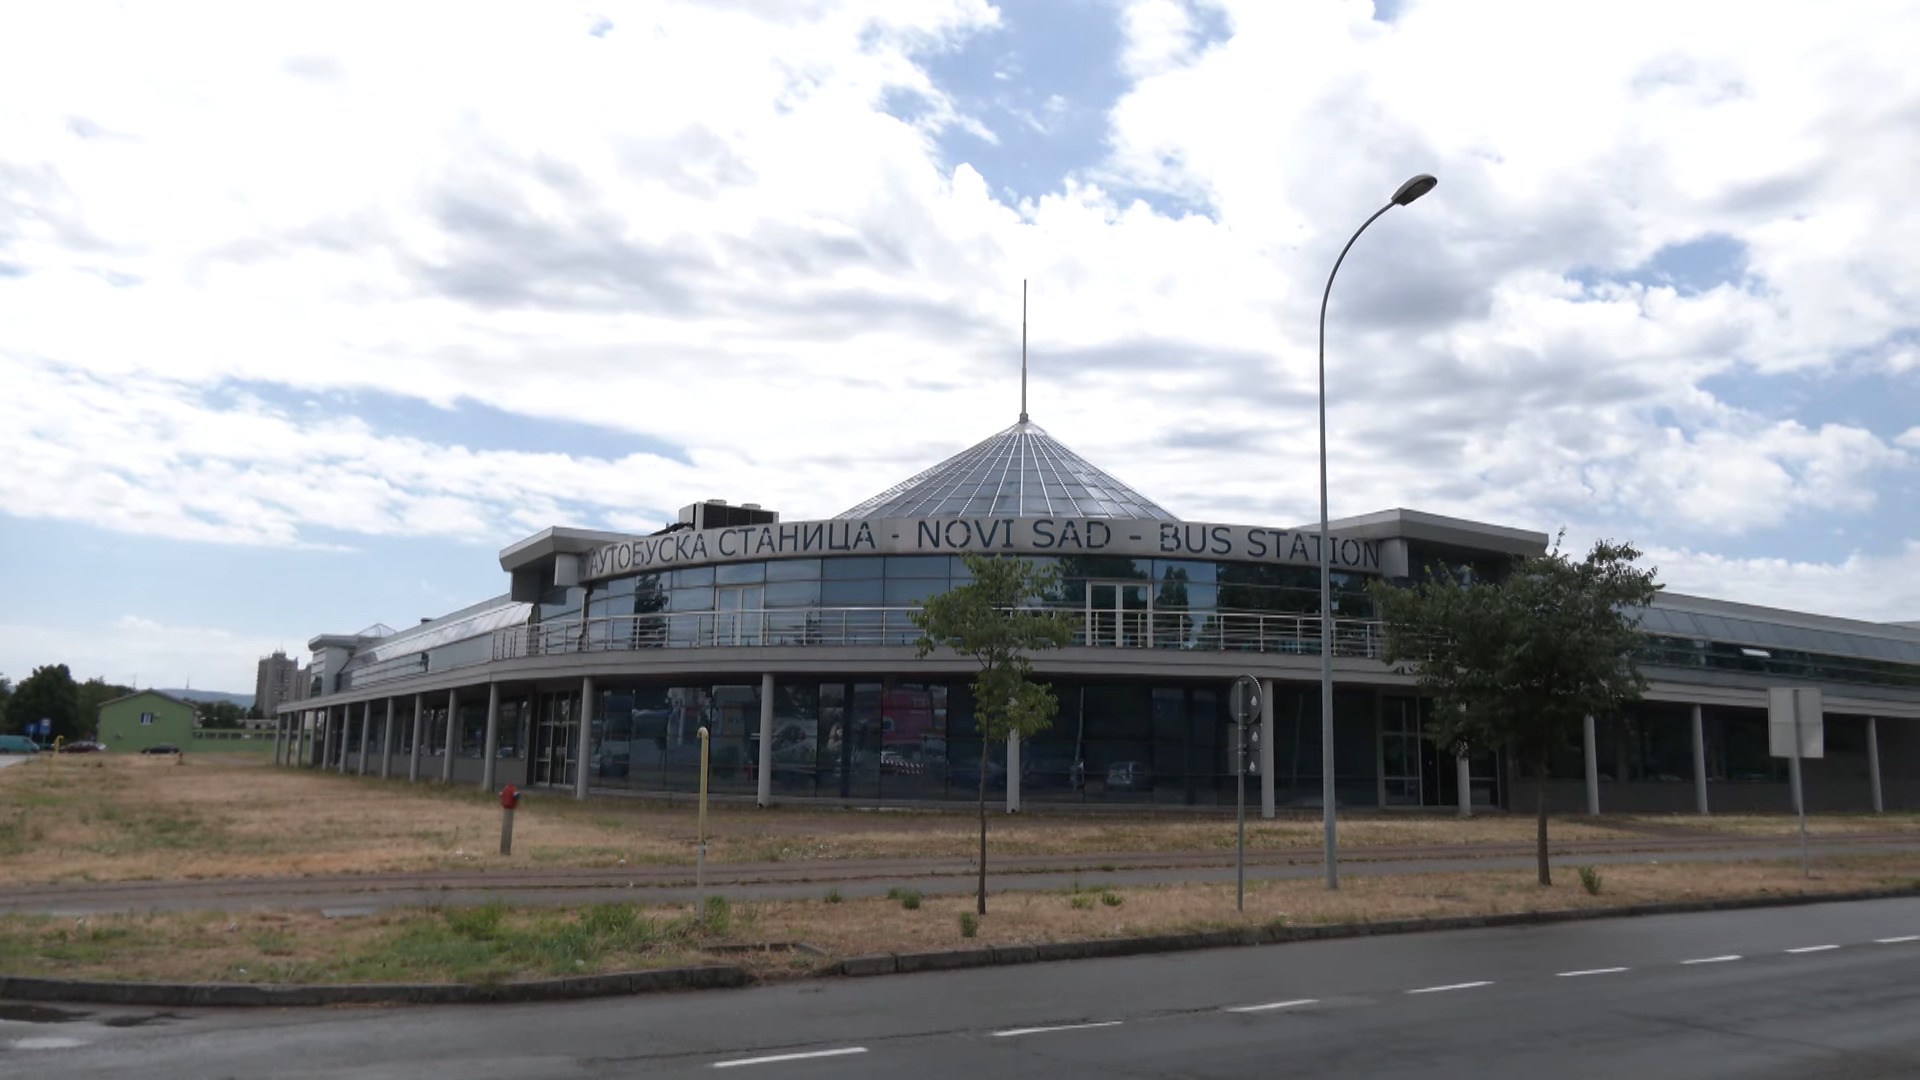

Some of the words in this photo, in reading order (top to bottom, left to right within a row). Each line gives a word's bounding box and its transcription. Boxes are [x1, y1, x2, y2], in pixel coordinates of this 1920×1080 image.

[590, 533, 707, 575] АУТОБУСКА
[718, 521, 875, 557] СТАНИЦА
[918, 519, 1014, 549] NOVI
[1032, 519, 1111, 549] SAD
[1160, 523, 1232, 554] BUS
[1247, 528, 1380, 569] STATION
